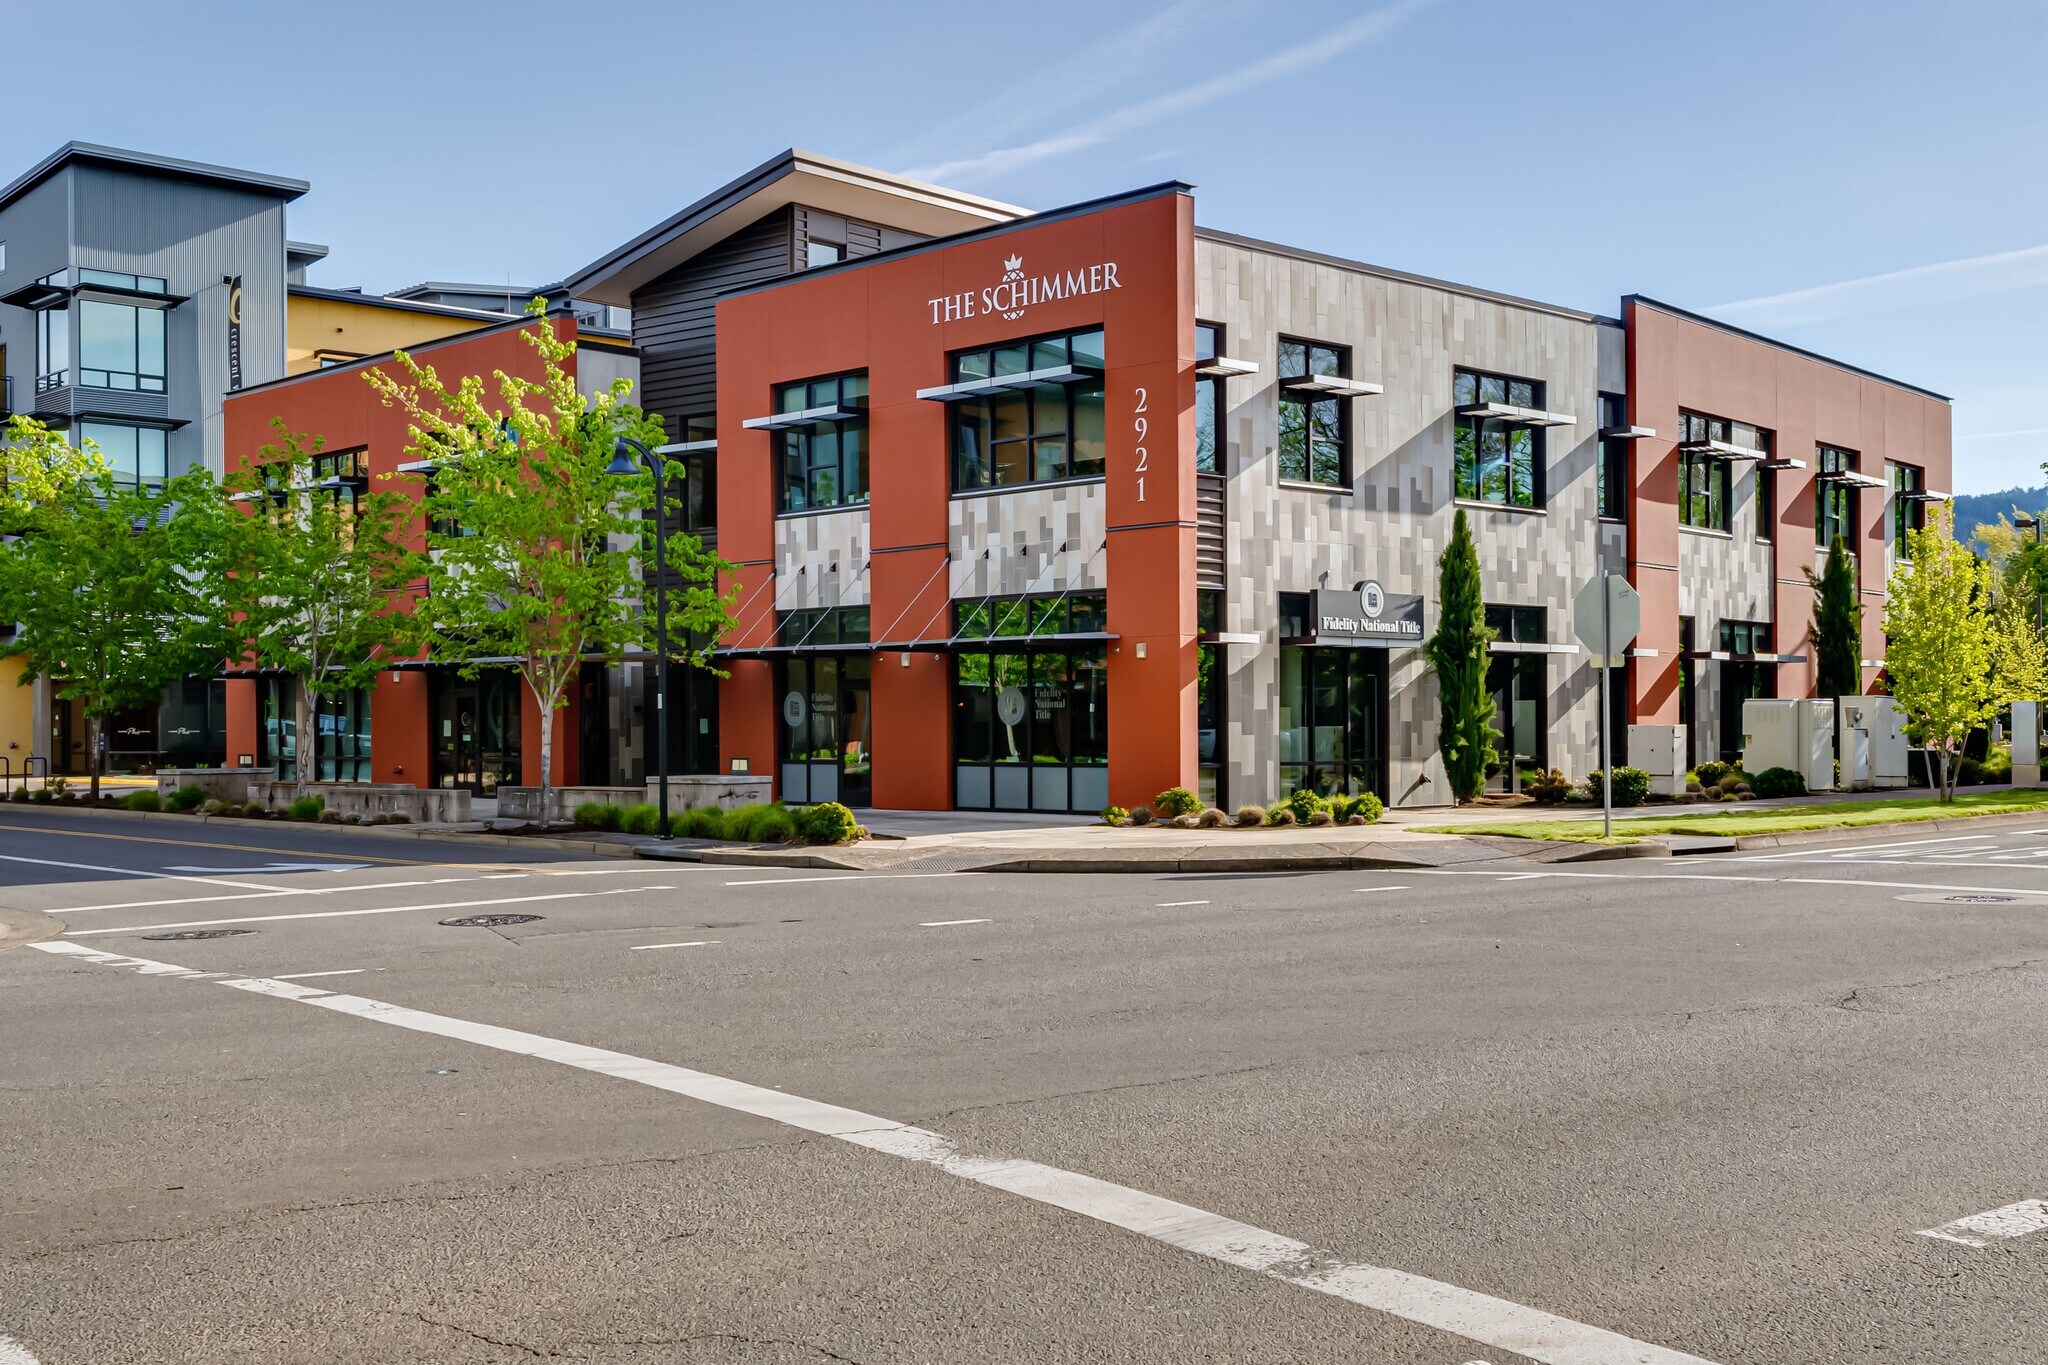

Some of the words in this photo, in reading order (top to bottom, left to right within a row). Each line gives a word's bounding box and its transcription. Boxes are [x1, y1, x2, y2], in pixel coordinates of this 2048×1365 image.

[928, 291, 976, 325] THE
[982, 262, 1123, 315] SCHIMMER
[230, 328, 240, 379] crescent
[1134, 387, 1148, 502] 2921
[1322, 616, 1359, 634] Fidelity
[1360, 618, 1399, 633] National
[1400, 620, 1421, 634] Title
[1034, 699, 1066, 709] National
[1034, 710, 1052, 720] Title
